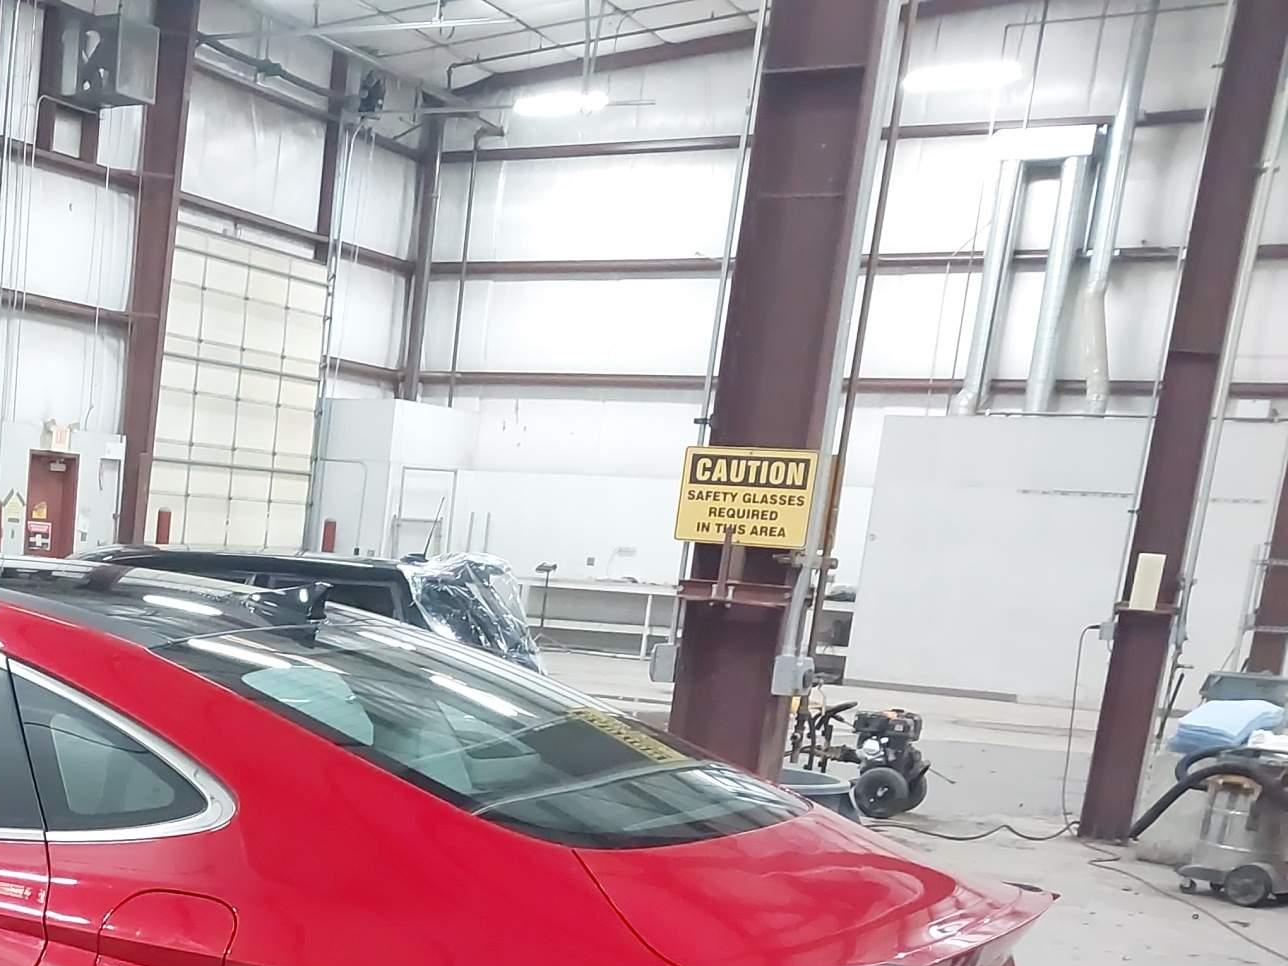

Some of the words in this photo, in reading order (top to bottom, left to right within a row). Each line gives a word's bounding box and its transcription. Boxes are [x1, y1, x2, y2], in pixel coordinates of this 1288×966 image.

[696, 457, 805, 486] CAUTION
[687, 489, 739, 502] SAFETY
[742, 493, 805, 507] GLASSES
[708, 506, 779, 521] REQUIRED
[696, 521, 711, 533] IN
[749, 525, 787, 538] AREA
